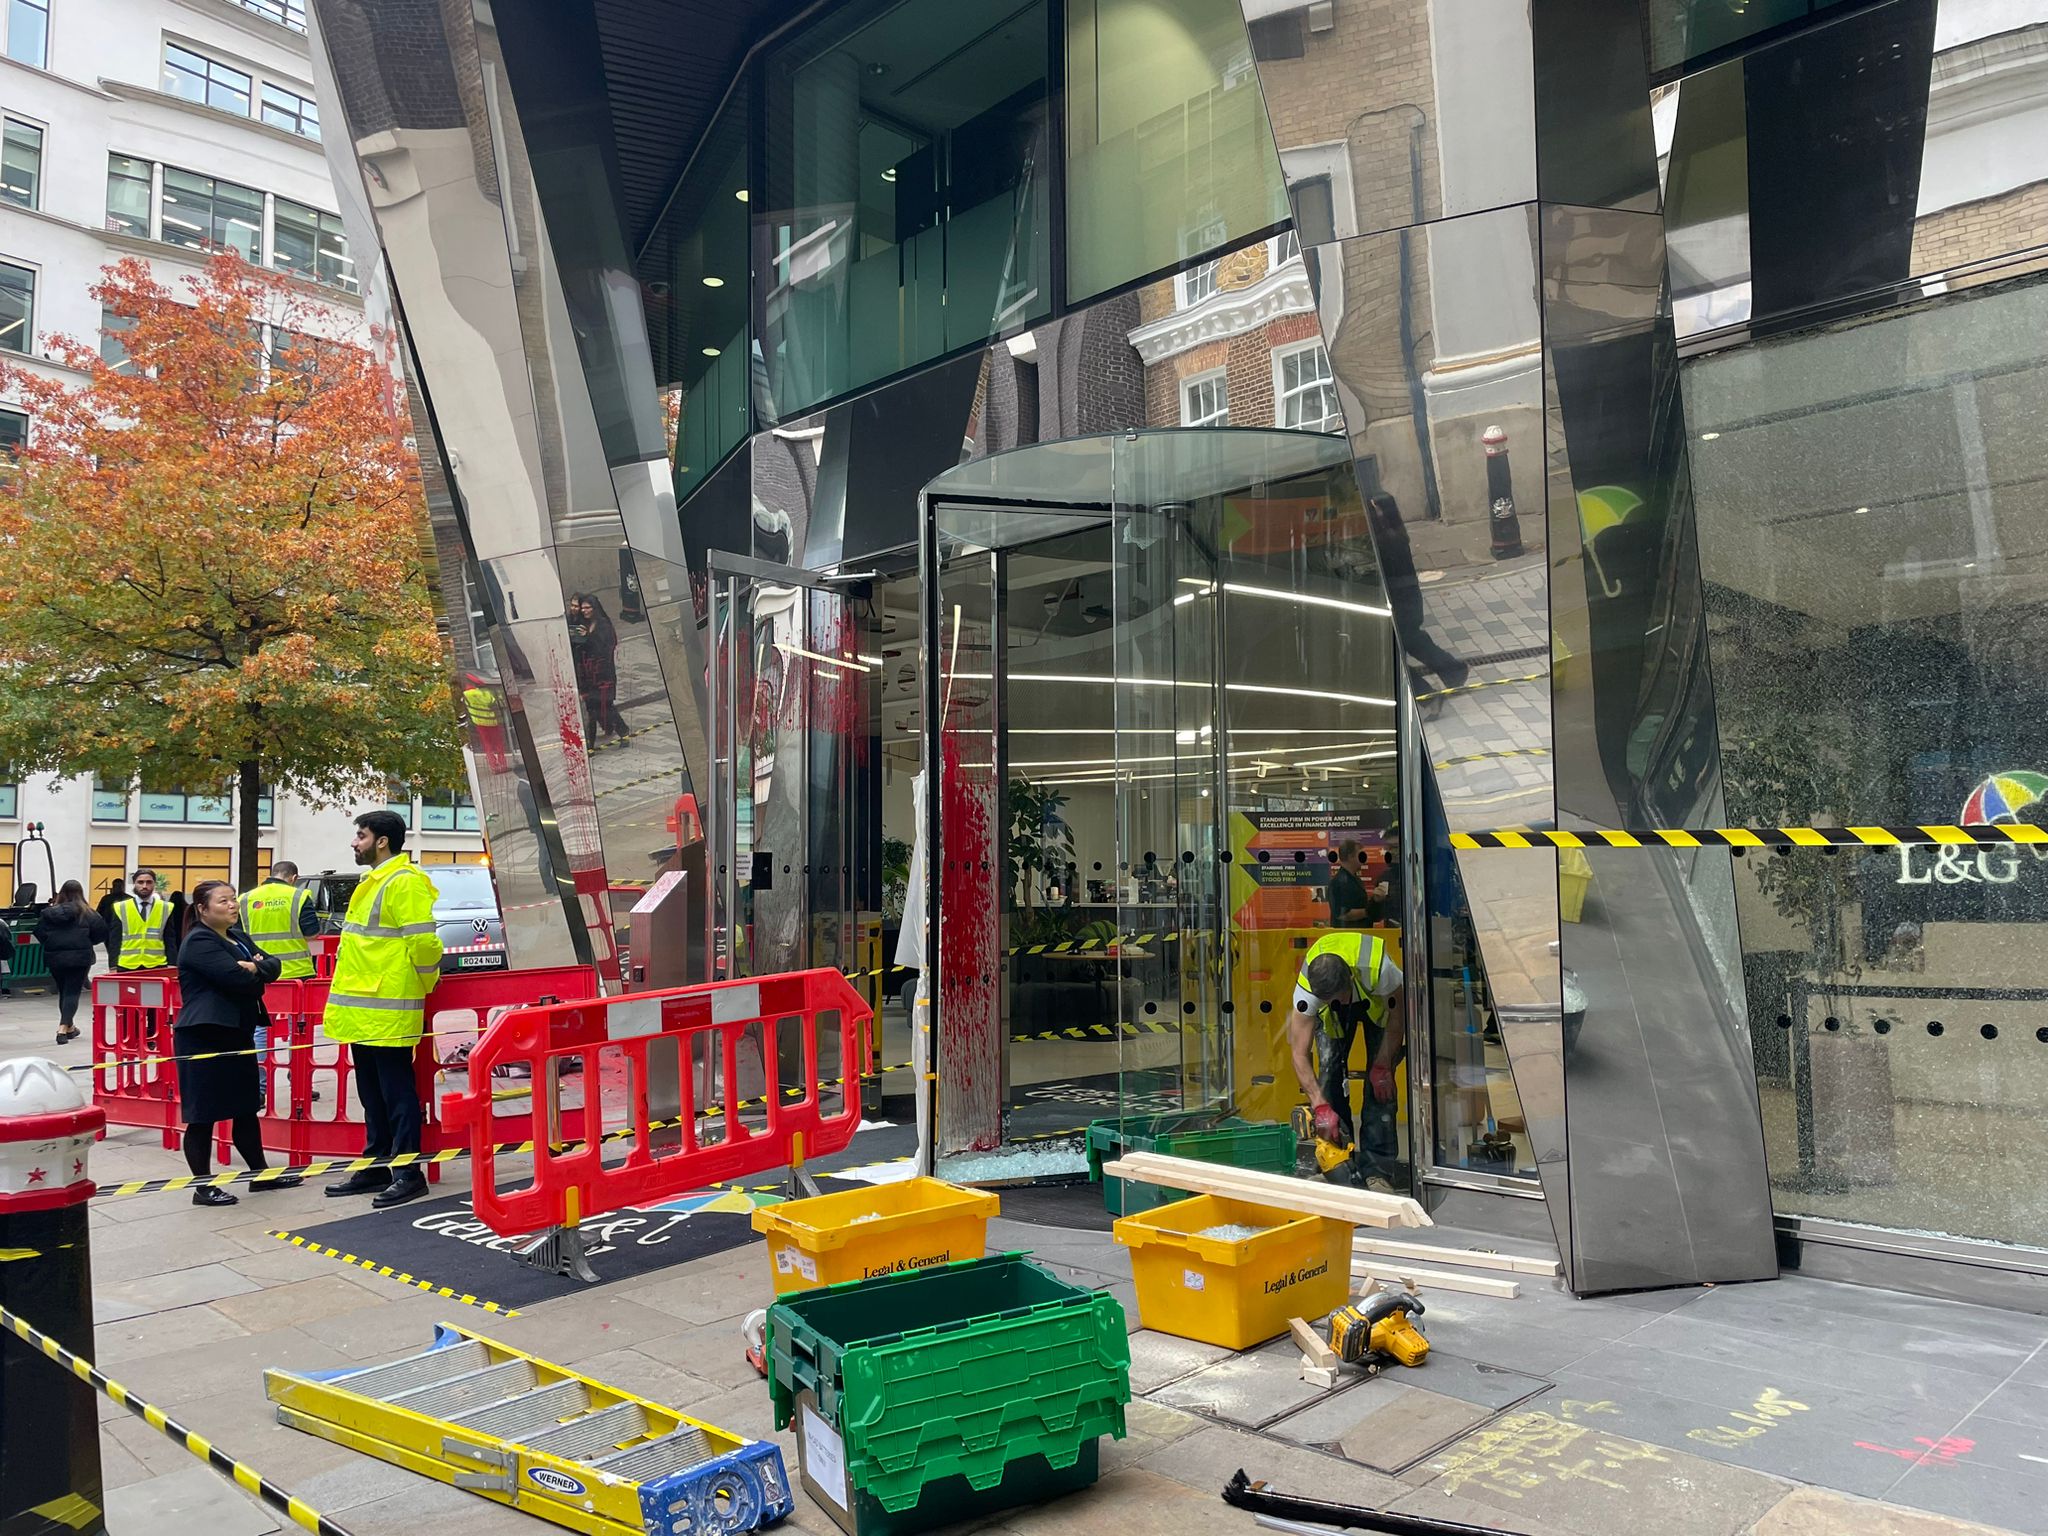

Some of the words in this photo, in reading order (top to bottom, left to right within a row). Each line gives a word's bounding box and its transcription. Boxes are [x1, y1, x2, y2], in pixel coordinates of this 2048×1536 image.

[150, 802, 174, 811] Collins
[1896, 843, 2022, 884] L&G
[463, 957, 484, 965] RO24
[485, 956, 500, 964] NUU
[863, 1262, 894, 1280] Legal
[896, 1259, 905, 1272] &
[908, 1250, 950, 1269] General
[1264, 1275, 1288, 1294] Legal
[1289, 1272, 1296, 1285] &
[1298, 1260, 1328, 1282] General
[538, 1471, 576, 1490] WERNER
